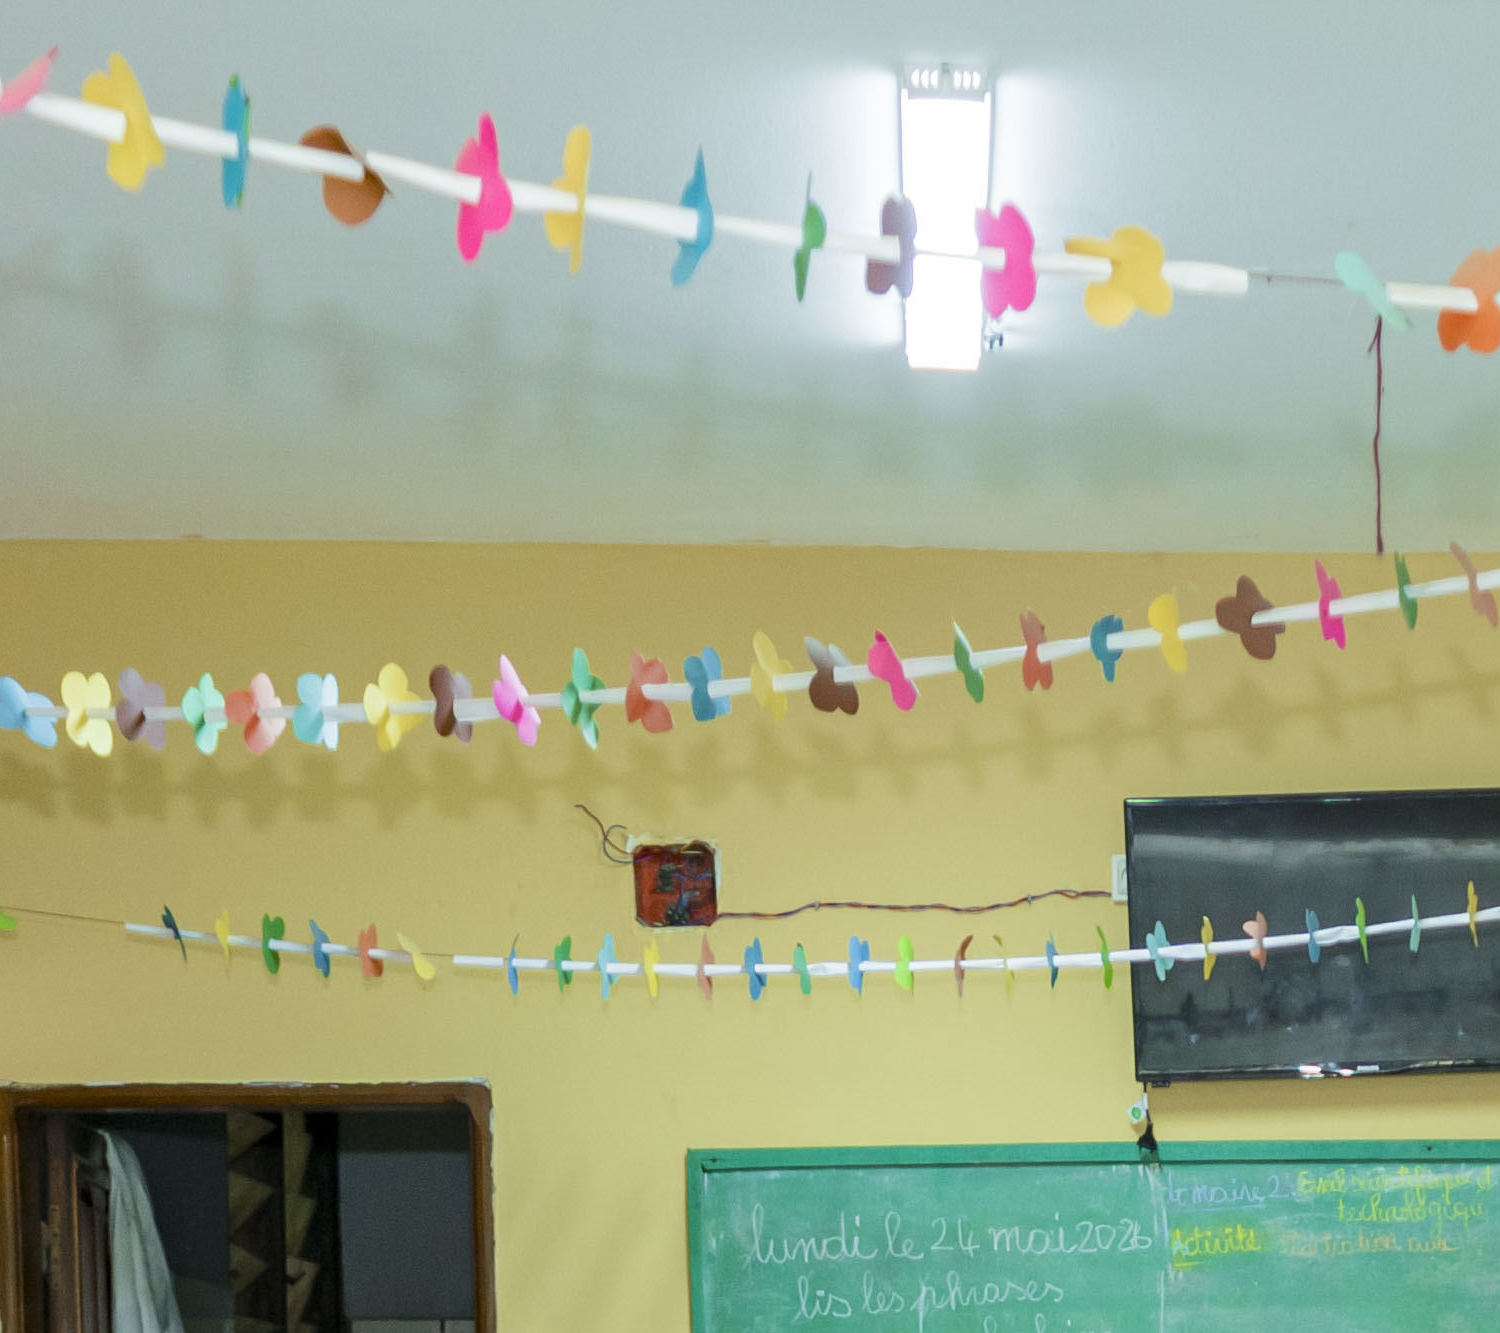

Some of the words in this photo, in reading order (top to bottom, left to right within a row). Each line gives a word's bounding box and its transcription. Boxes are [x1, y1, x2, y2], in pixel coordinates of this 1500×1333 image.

[747, 1203, 878, 1264] lundi
[885, 1211, 923, 1261] le
[931, 1218, 980, 1258] 24
[988, 1211, 1077, 1254] mai
[794, 1275, 852, 1322] lis
[862, 1271, 901, 1316] les
[910, 1270, 1065, 1333] phrases
